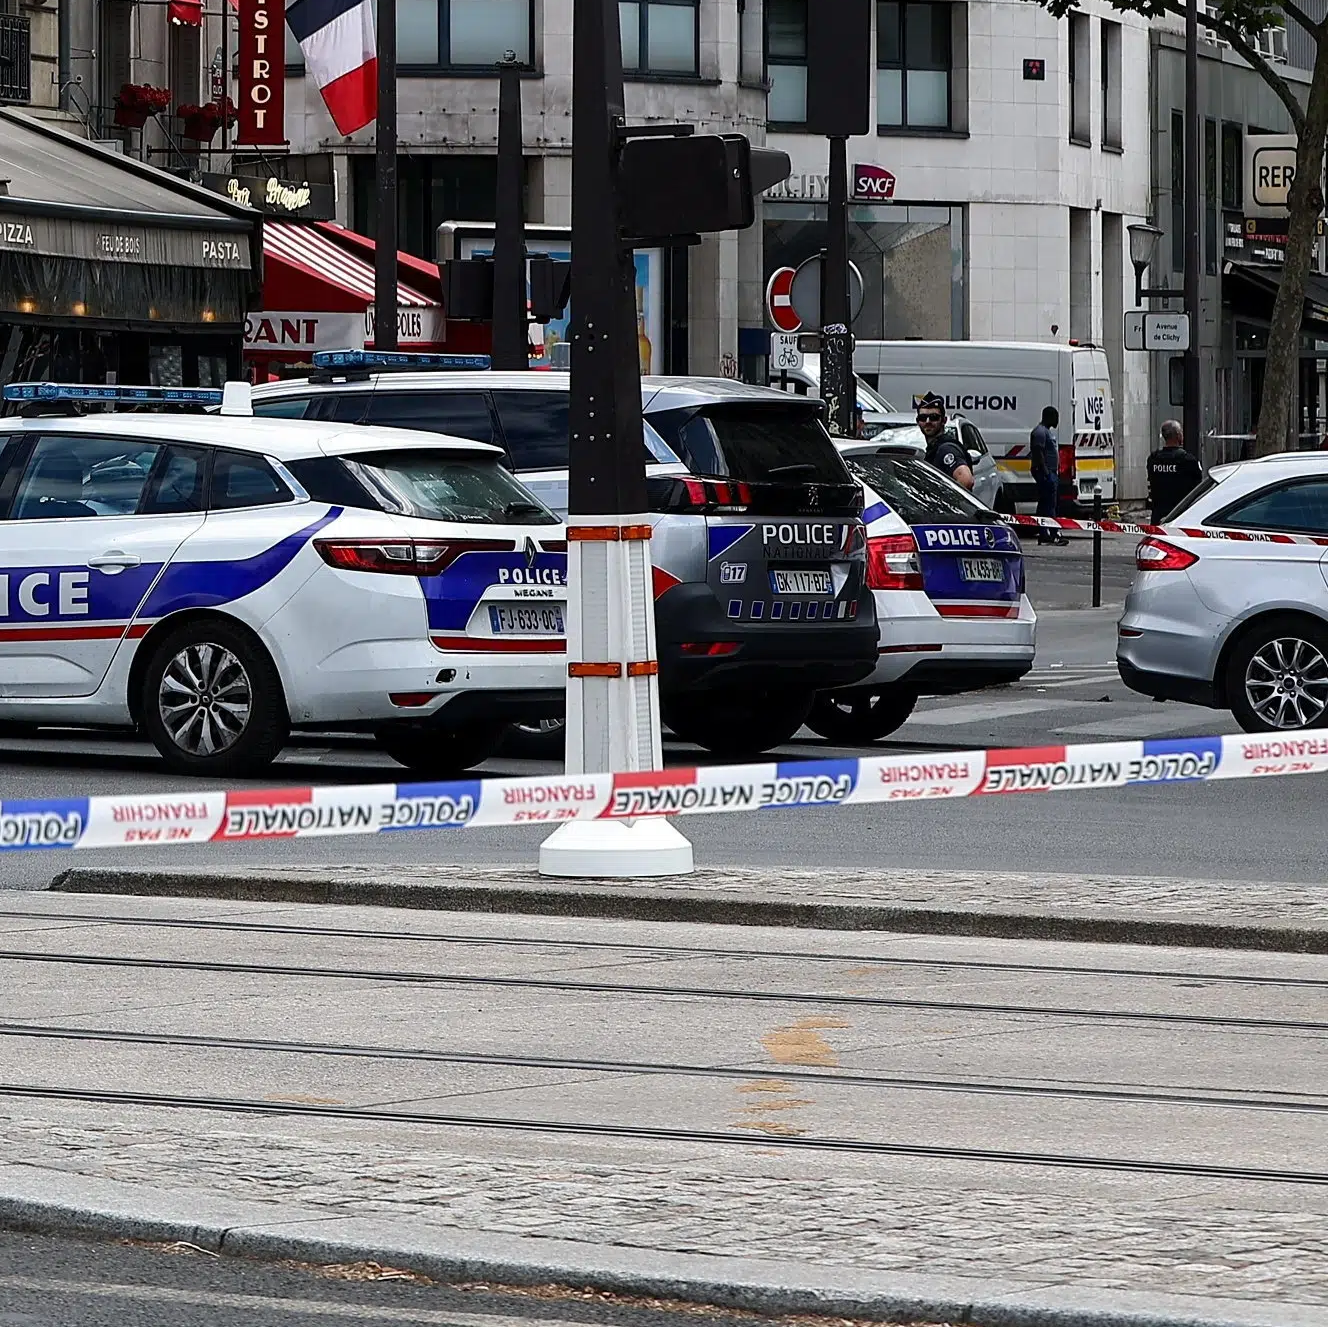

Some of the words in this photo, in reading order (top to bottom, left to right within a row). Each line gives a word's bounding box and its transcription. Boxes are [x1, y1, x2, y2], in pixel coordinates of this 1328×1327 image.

[856, 176, 894, 193] SNCF
[1259, 165, 1295, 188] RER
[115, 236, 124, 253] DE
[202, 240, 241, 261] PASTA
[1156, 322, 1178, 330] Avenue
[779, 335, 797, 345] SAUF
[1162, 333, 1181, 342] Clichy
[937, 395, 1017, 411] LICHON
[1087, 396, 1104, 414] NGE
[1152, 464, 1178, 473] POLICE
[762, 524, 834, 545] POLICE
[924, 529, 981, 546] POLICE
[498, 567, 561, 585] POLICE
[730, 565, 746, 580] 17
[513, 589, 554, 598] MEGANE
[1242, 739, 1328, 759] FRANCHIR
[879, 763, 969, 783] FRANCHIR
[989, 761, 1121, 790] NATIONALE
[1126, 753, 1217, 781] POLICE
[1251, 764, 1283, 775] PAS
[1287, 762, 1315, 773] NE
[502, 784, 596, 803] FRANCHIR
[758, 775, 849, 803] POLICE
[888, 788, 925, 800] PAS
[927, 785, 953, 797] NE
[615, 785, 754, 814] NATIONALE
[111, 803, 208, 823] FRANCHIR
[230, 803, 371, 835] NATIONALE
[379, 796, 474, 826] POLICE
[513, 808, 549, 823] PAS
[553, 806, 580, 821] NE
[123, 829, 163, 843] PAS
[166, 826, 194, 840] NE
